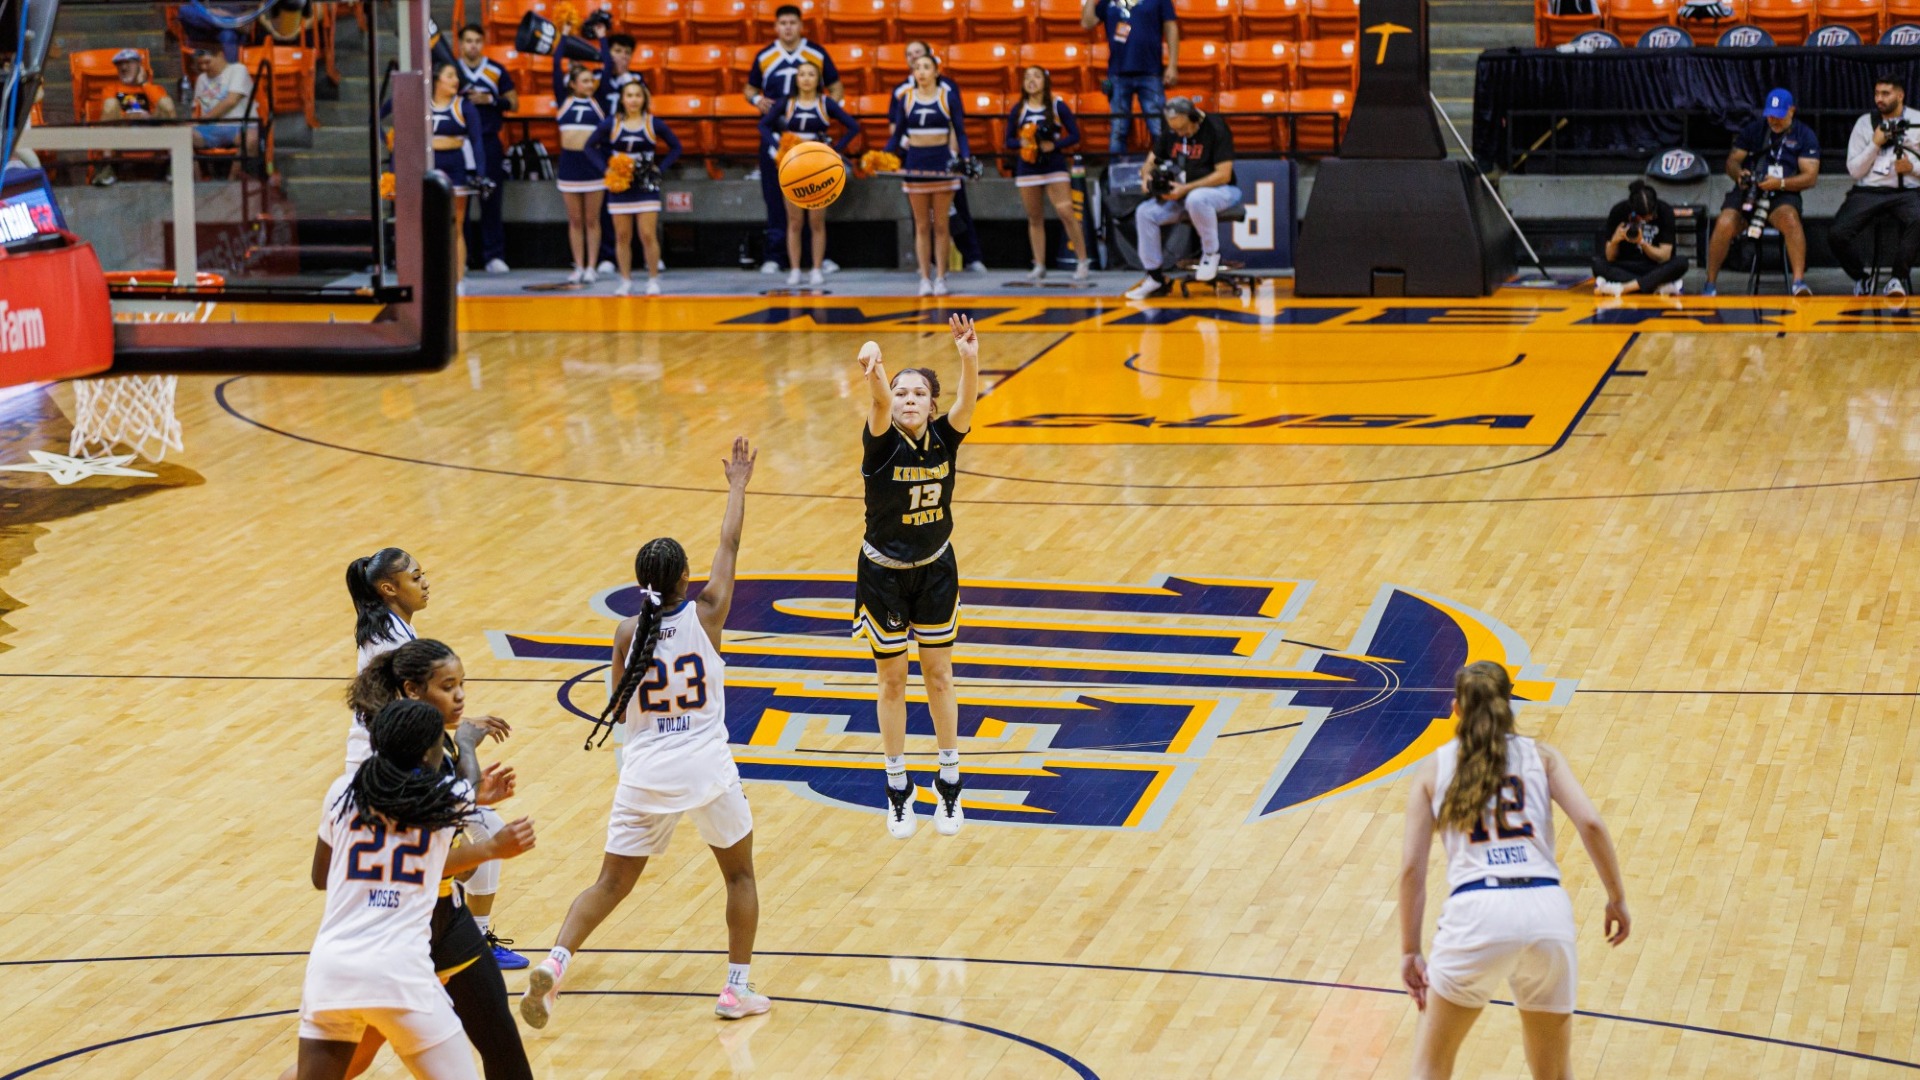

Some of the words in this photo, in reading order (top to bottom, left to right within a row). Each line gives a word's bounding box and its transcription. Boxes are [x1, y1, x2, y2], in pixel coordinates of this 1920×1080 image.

[792, 176, 835, 199] Wilson
[908, 482, 943, 511] 13
[901, 506, 944, 526] STATE
[638, 652, 708, 714] 23
[656, 715, 691, 734] WOLDAI
[346, 810, 434, 886] 22
[1487, 846, 1527, 865] ASENSIO
[368, 889, 401, 909] MOSES
